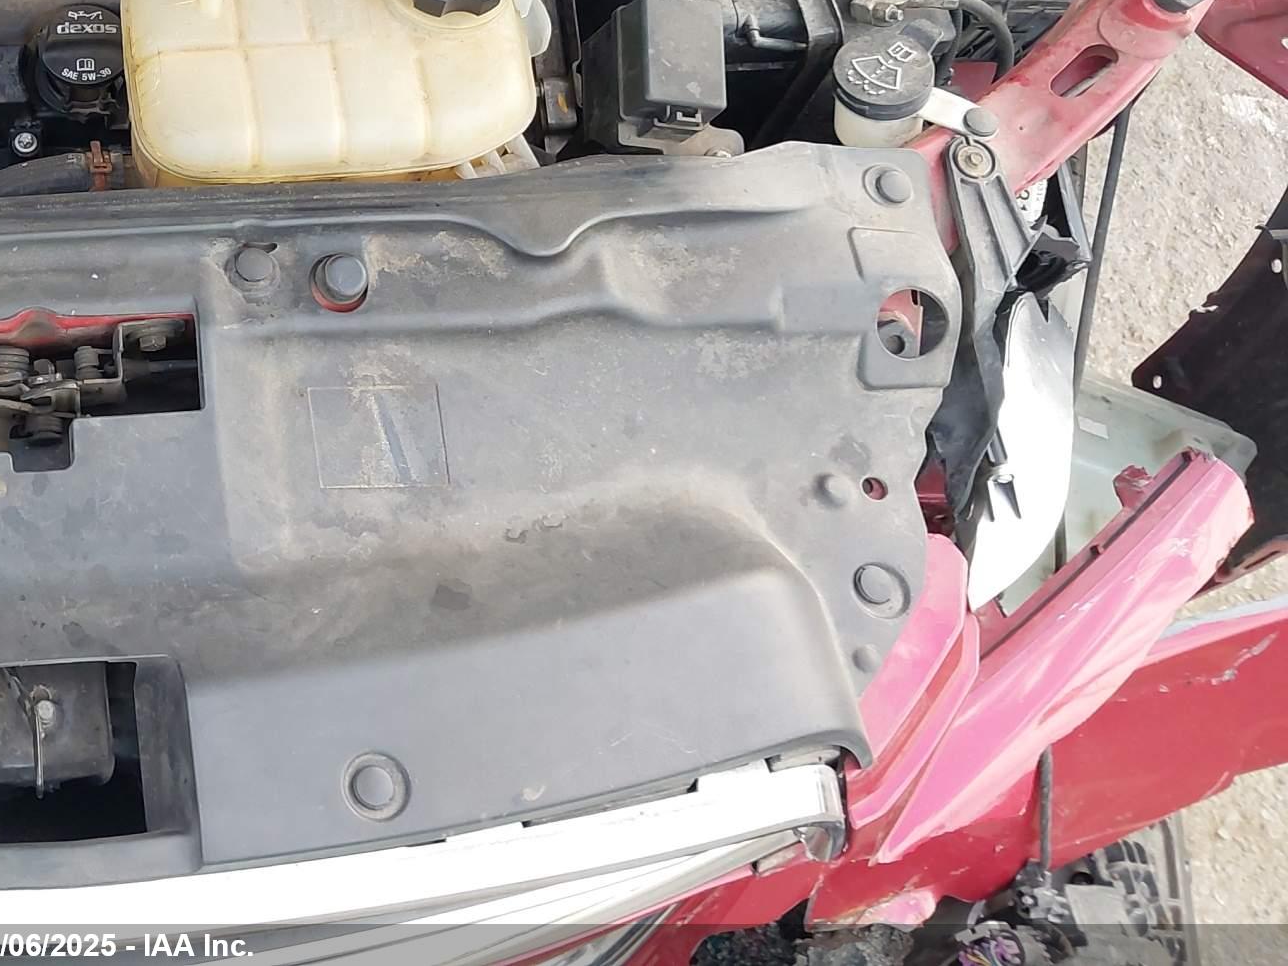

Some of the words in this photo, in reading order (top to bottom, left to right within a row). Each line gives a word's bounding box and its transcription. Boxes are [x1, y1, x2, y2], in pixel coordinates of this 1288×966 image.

[56, 22, 119, 34] dexos
[61, 68, 79, 80] SAE
[81, 67, 112, 81] 5W-30
